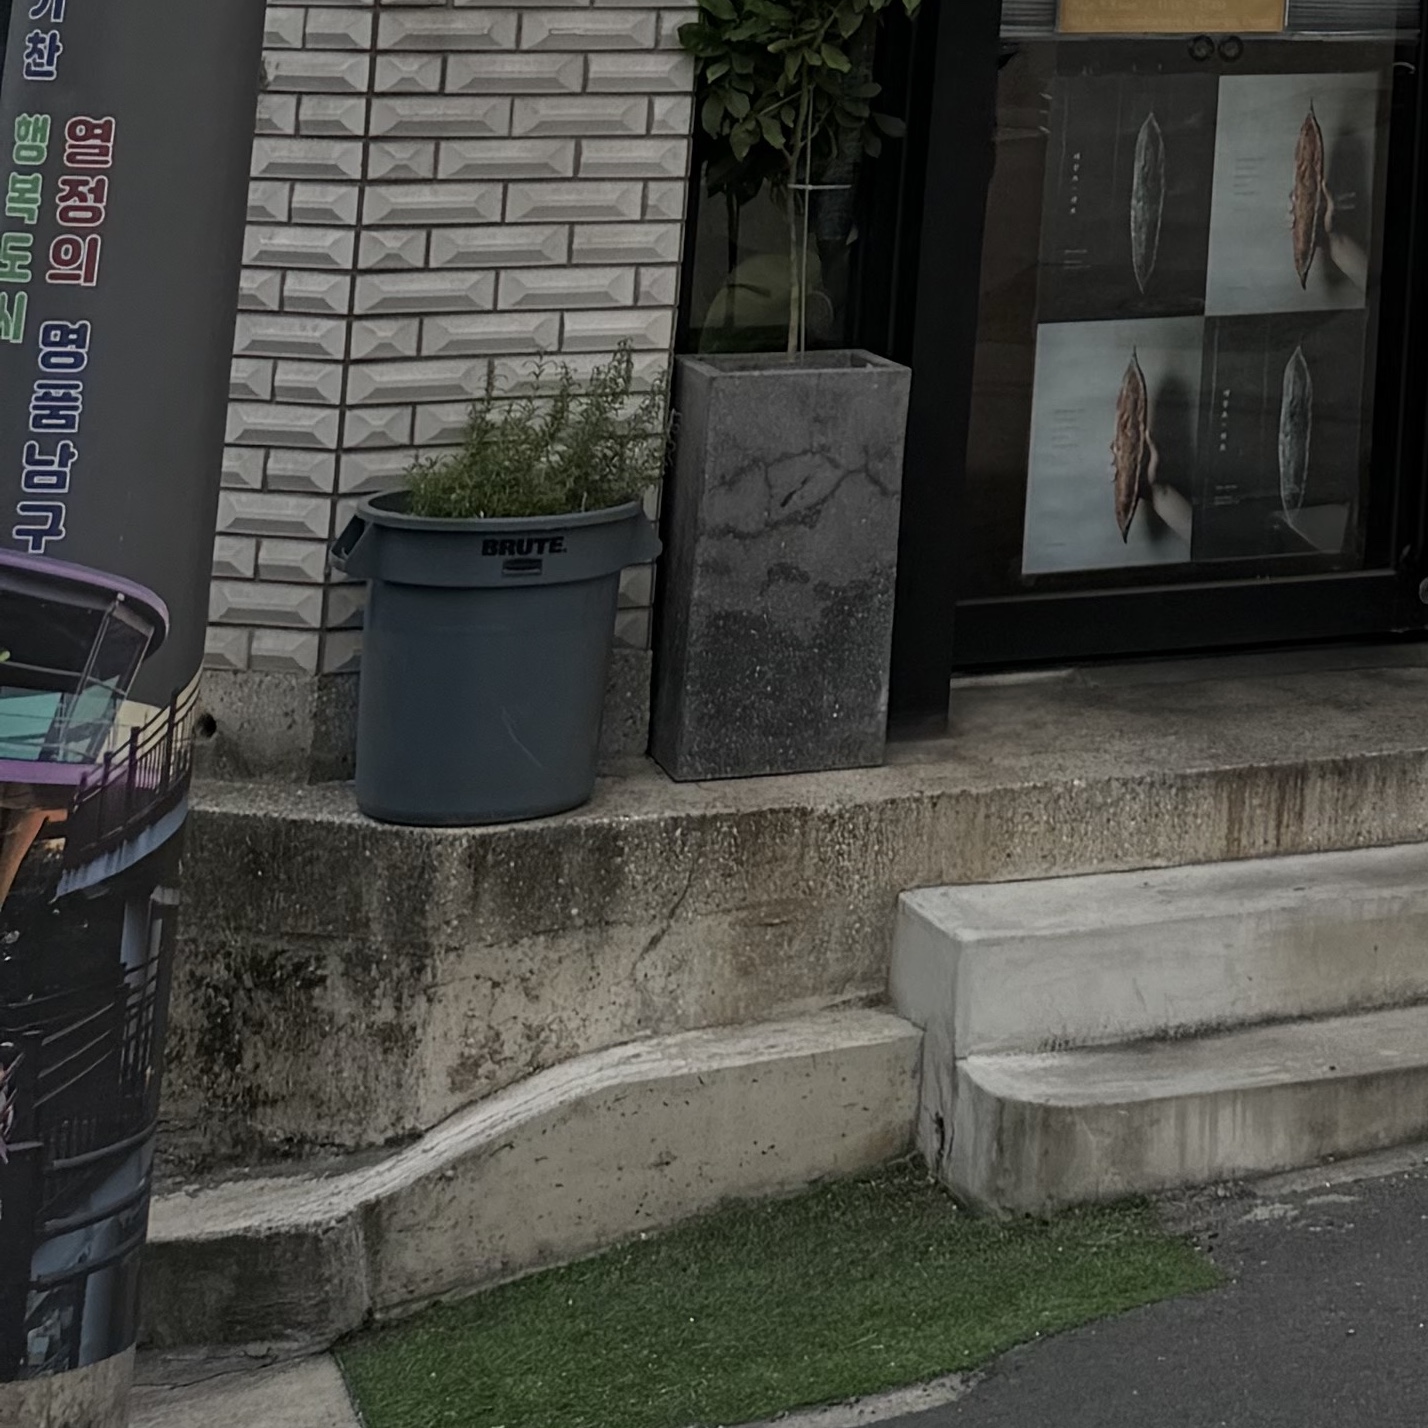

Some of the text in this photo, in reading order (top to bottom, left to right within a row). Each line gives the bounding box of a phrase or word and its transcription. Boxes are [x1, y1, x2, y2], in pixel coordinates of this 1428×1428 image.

[12, 114, 115, 555] 열정의 명품남구
[482, 535, 565, 556] BRUTE
